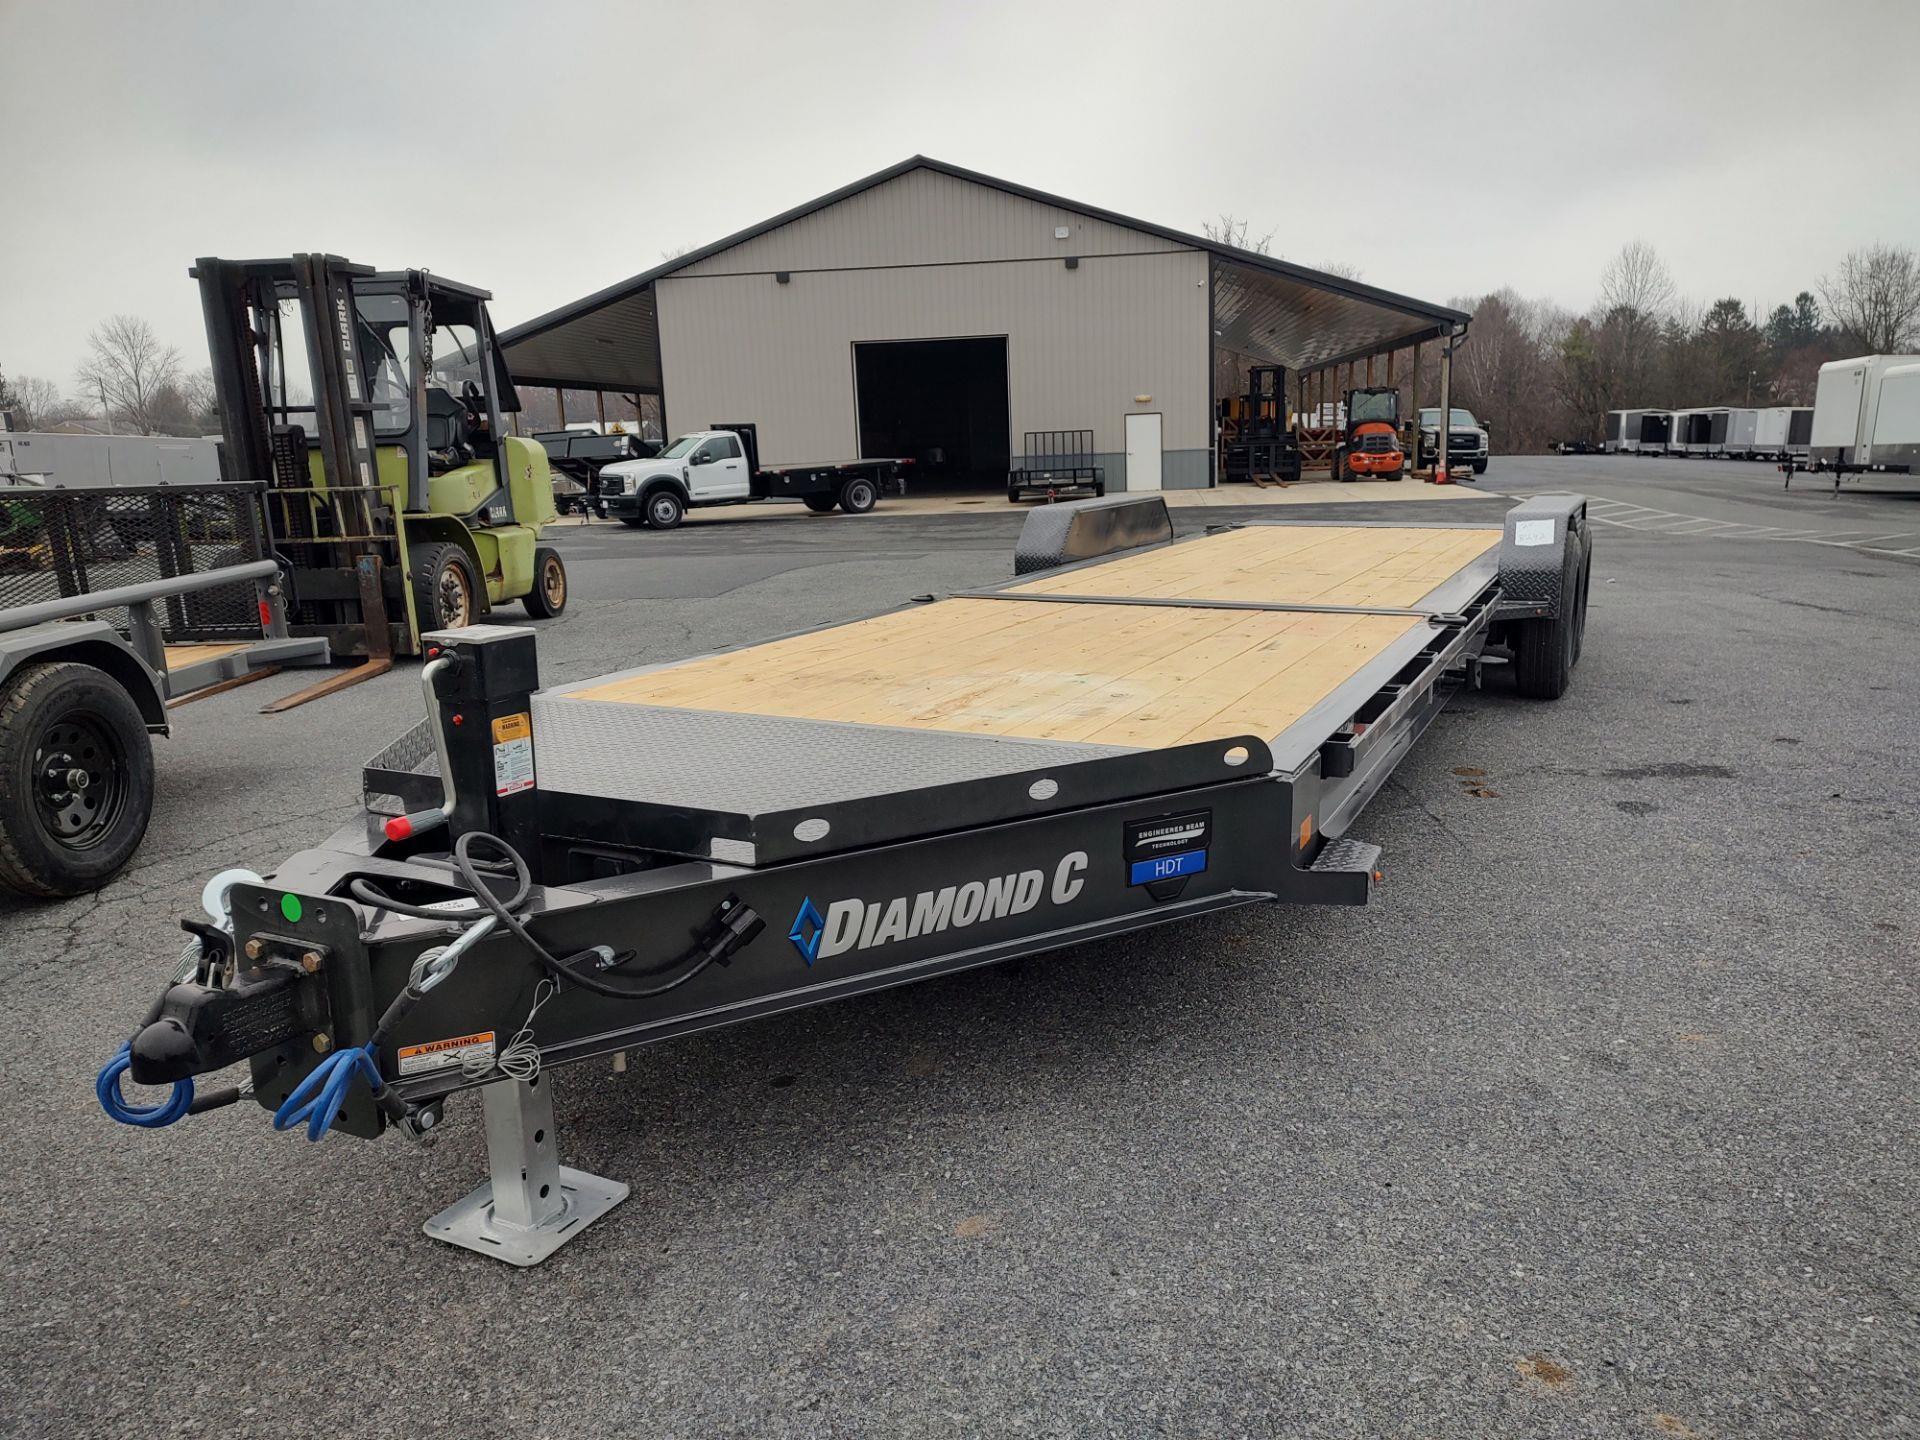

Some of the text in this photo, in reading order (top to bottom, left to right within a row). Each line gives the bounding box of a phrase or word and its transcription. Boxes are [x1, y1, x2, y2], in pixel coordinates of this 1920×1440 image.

[336, 298, 351, 351] CLARK
[489, 505, 507, 519] CLARK
[1138, 821, 1205, 839] ENGINEERED BEAM
[1152, 838, 1188, 849] TECHNOLOGY
[1155, 857, 1184, 877] HDT
[816, 850, 1089, 960] DIAMOND C
[425, 1036, 480, 1053] WARNING
